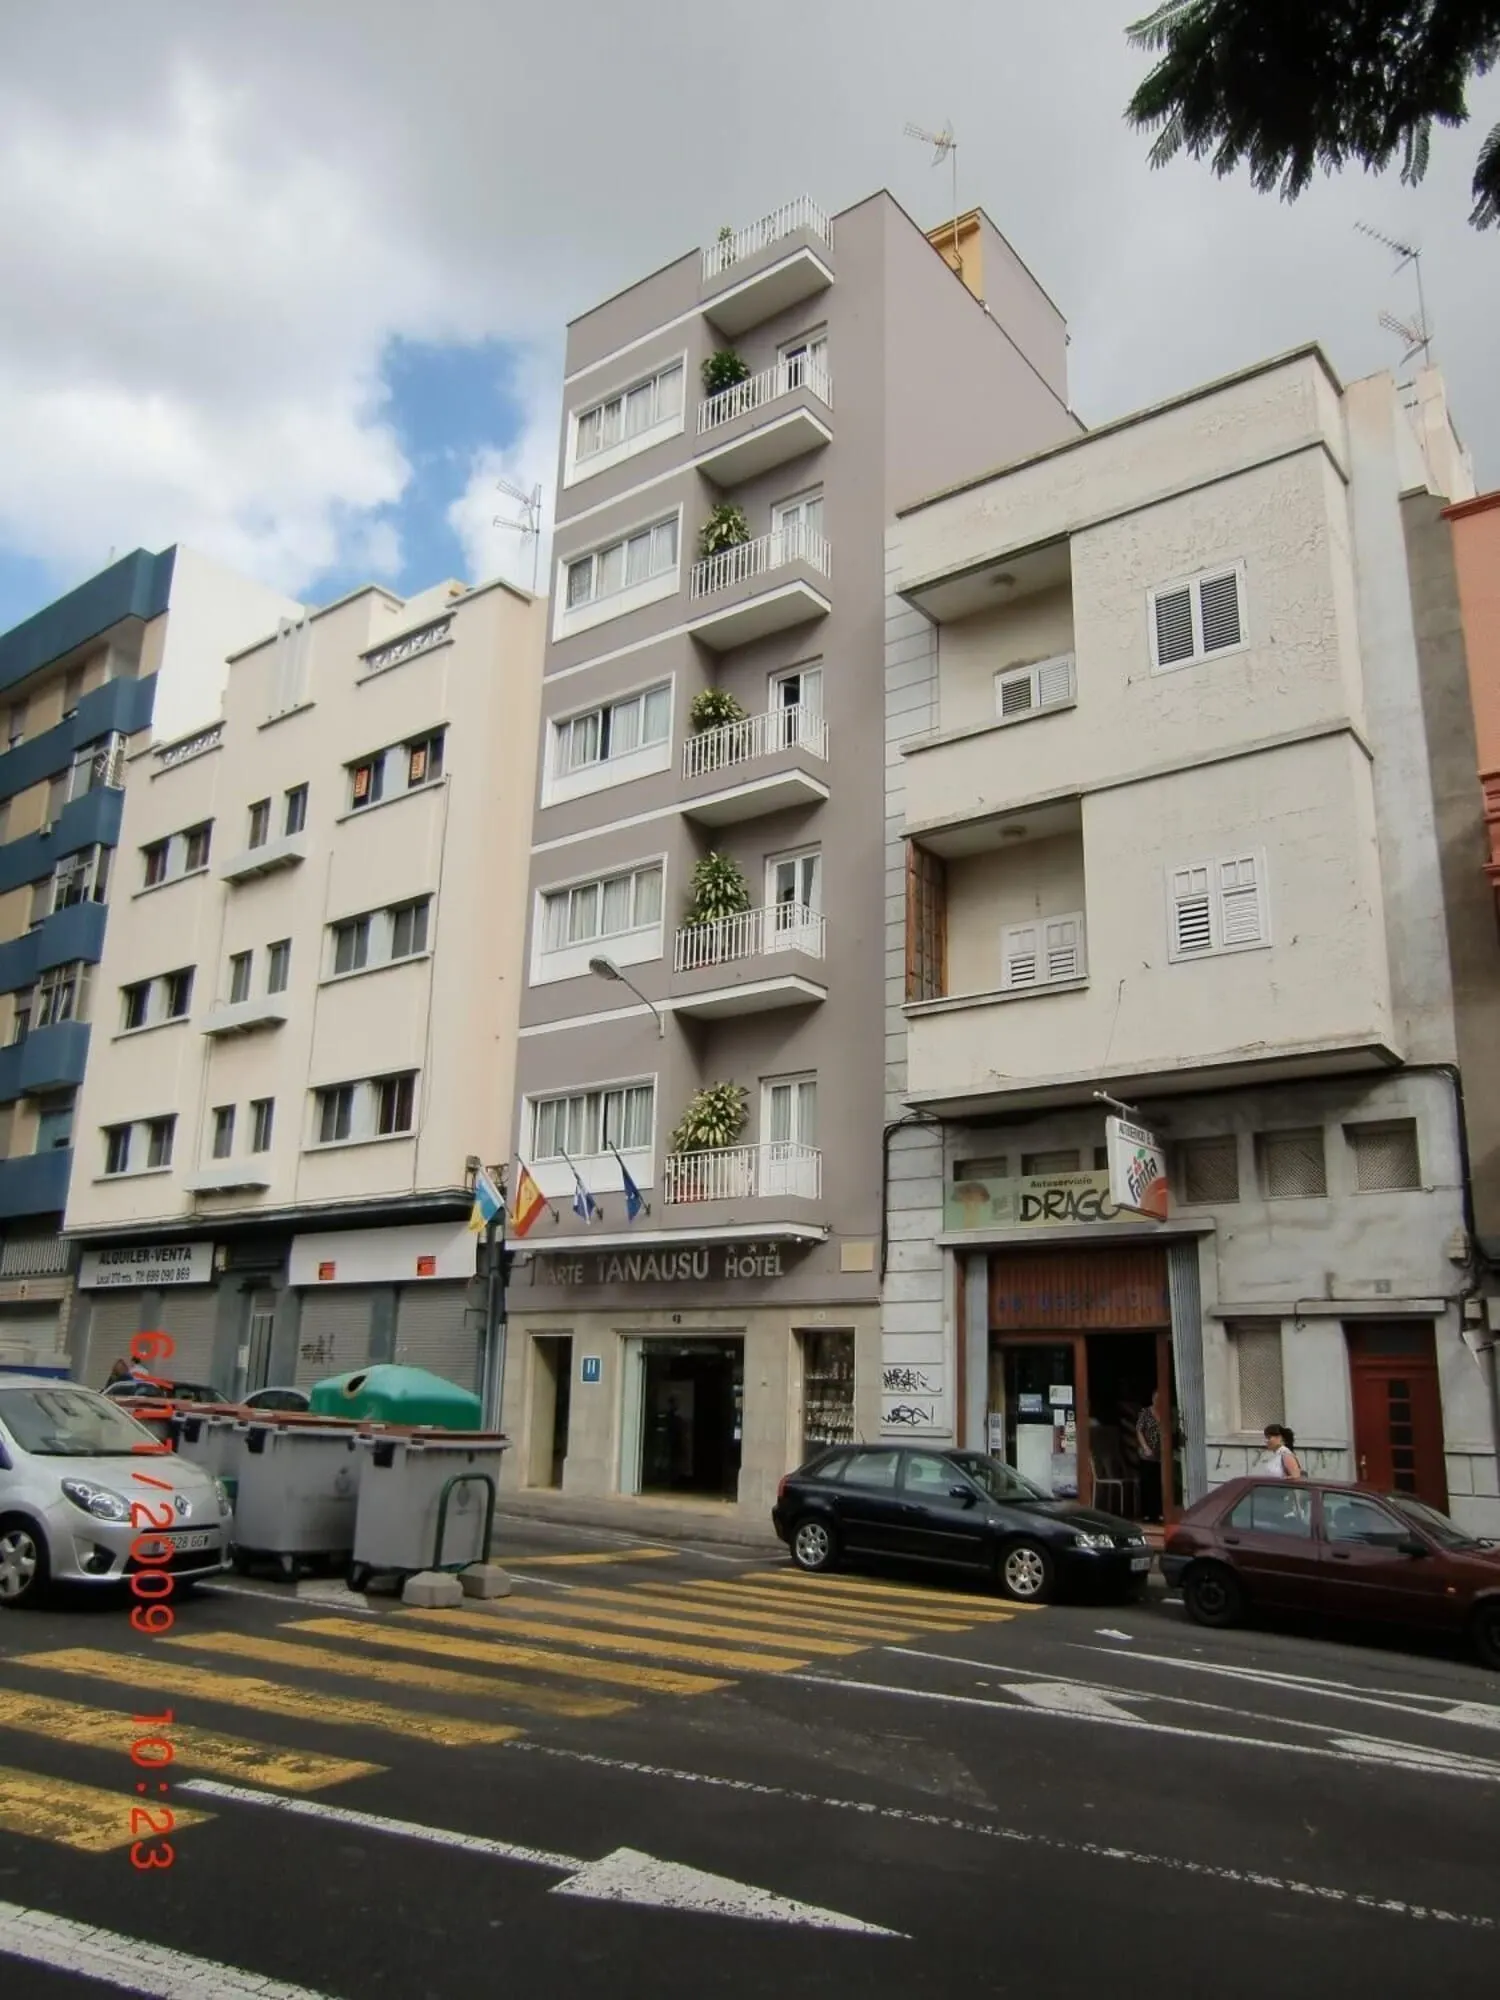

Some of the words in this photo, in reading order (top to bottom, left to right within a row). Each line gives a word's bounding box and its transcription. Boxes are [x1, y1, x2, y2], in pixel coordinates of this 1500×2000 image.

[1127, 1156, 1158, 1205] Fanta
[98, 1246, 192, 1266] ALQUILER-VENTA
[724, 1252, 784, 1279] HOTEL
